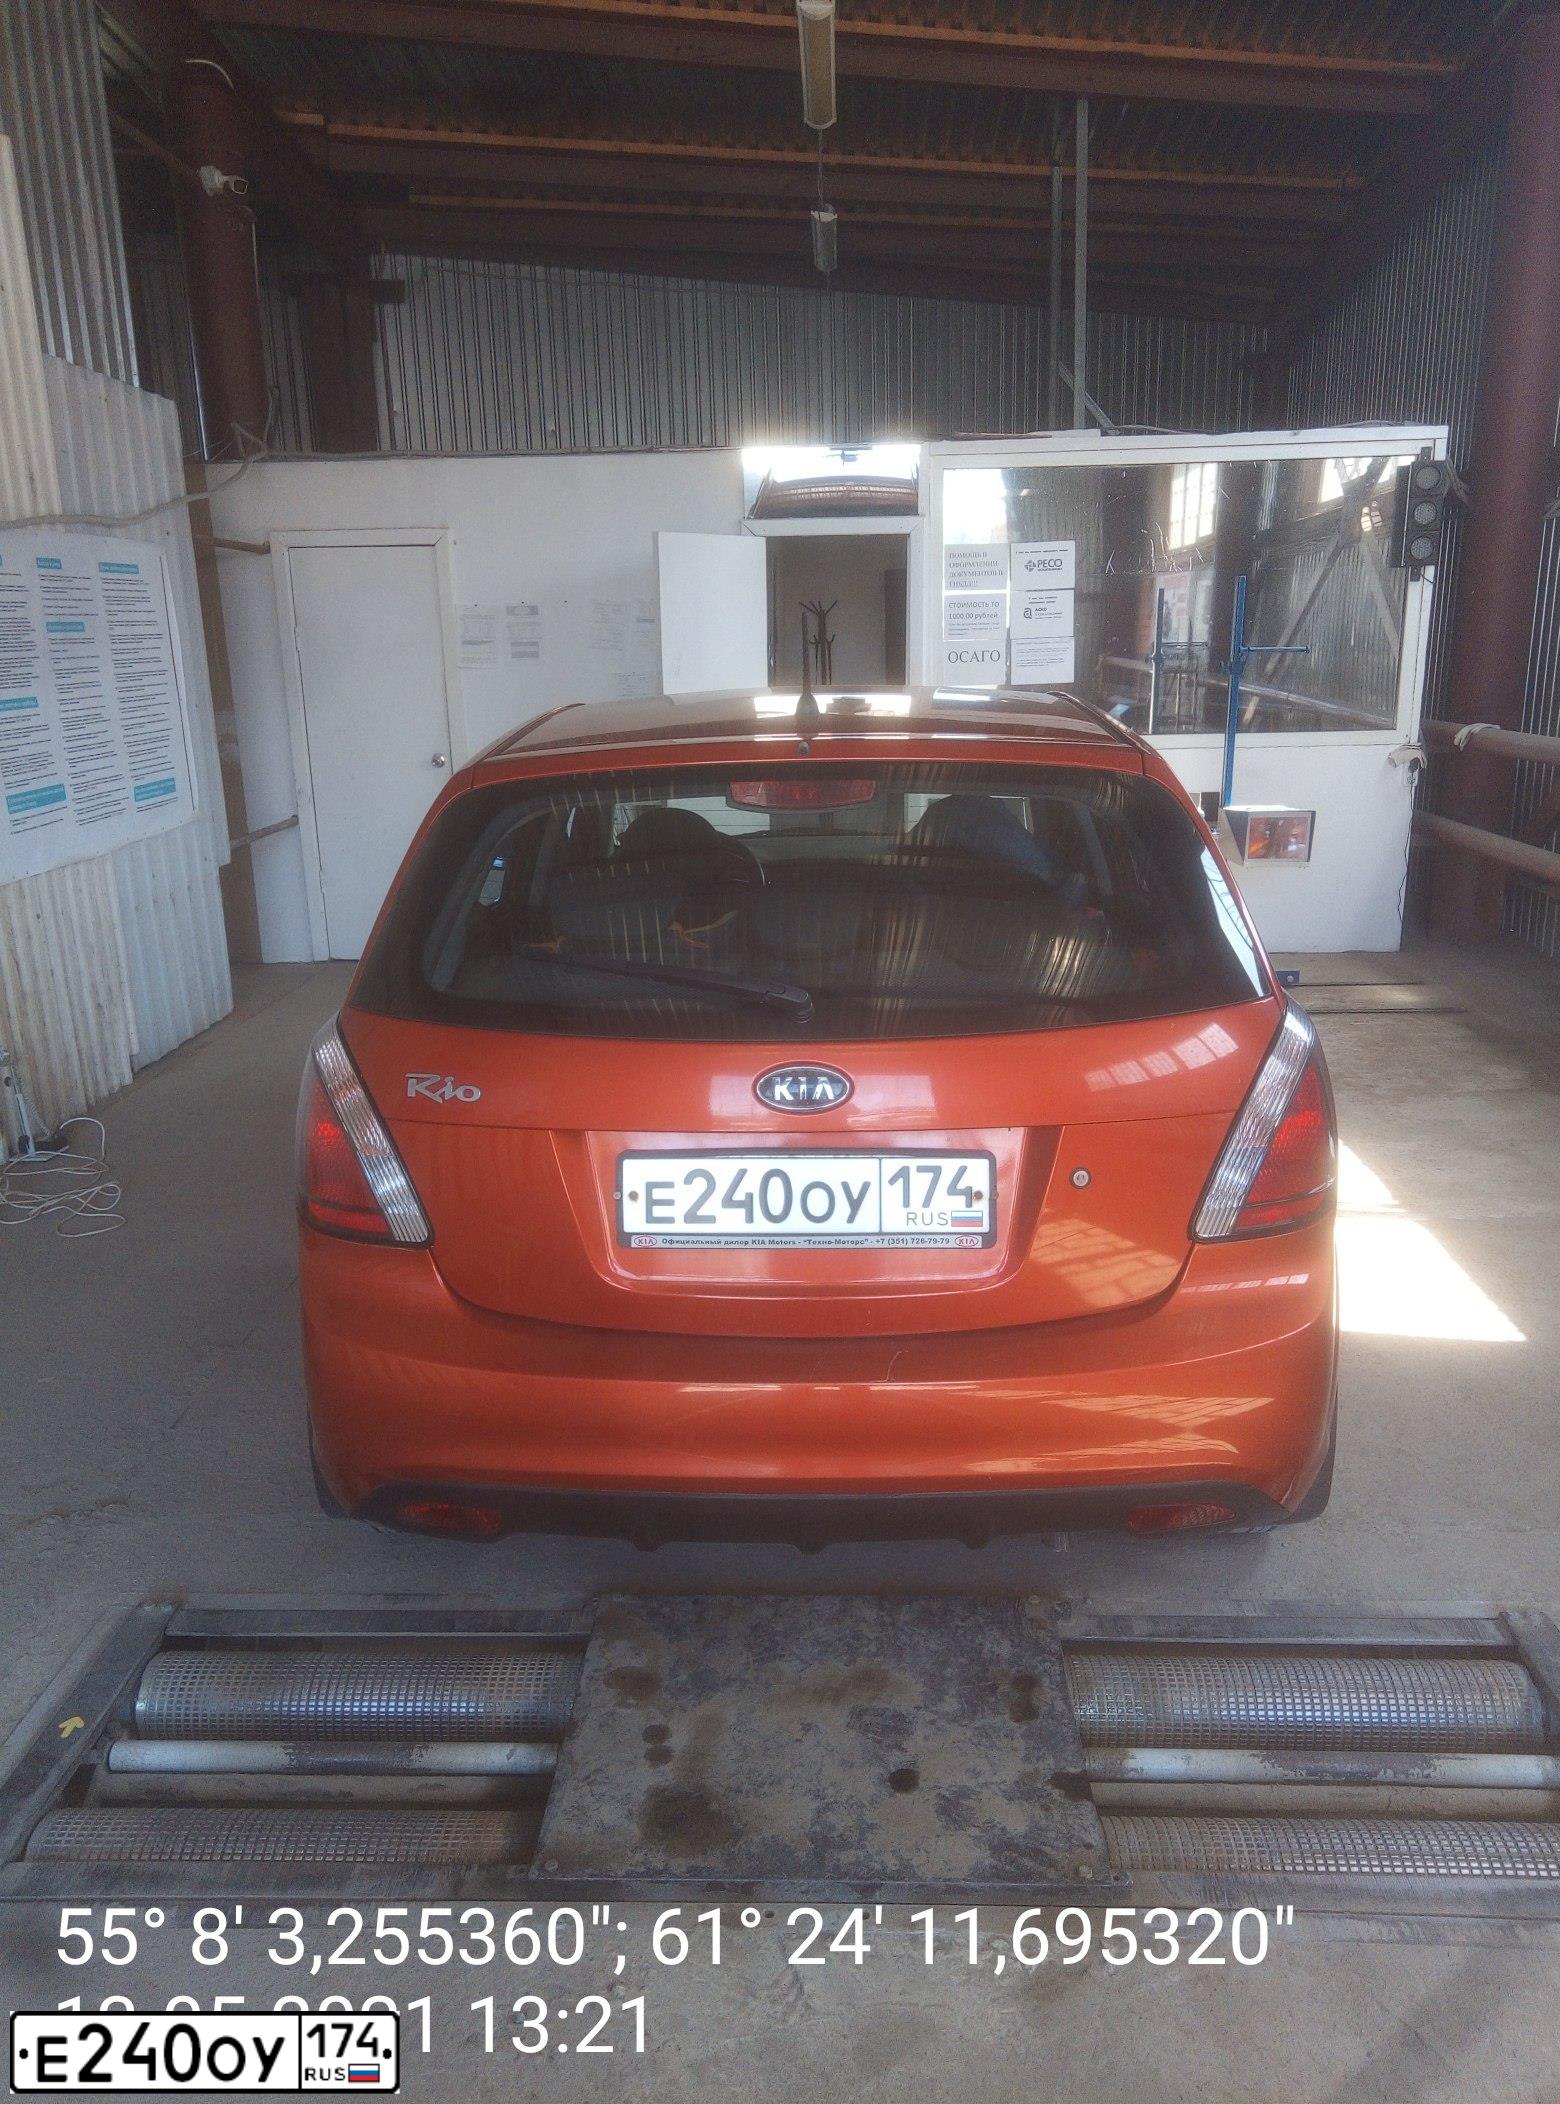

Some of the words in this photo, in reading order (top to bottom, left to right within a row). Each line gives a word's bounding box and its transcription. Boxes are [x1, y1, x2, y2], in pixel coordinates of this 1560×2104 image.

[1037, 558, 1063, 568] РЕСО
[974, 611, 998, 620] рублей
[948, 650, 1001, 664] ОСАГО
[405, 1072, 481, 1104] Rio
[772, 1076, 835, 1101] KIA
[887, 1165, 974, 1209] 174
[906, 1211, 949, 1226] RUS
[661, 1237, 722, 1246] Официальный
[751, 1237, 766, 1245] KIA
[768, 1237, 797, 1245] Motors
[875, 1237, 886, 1245] +7
